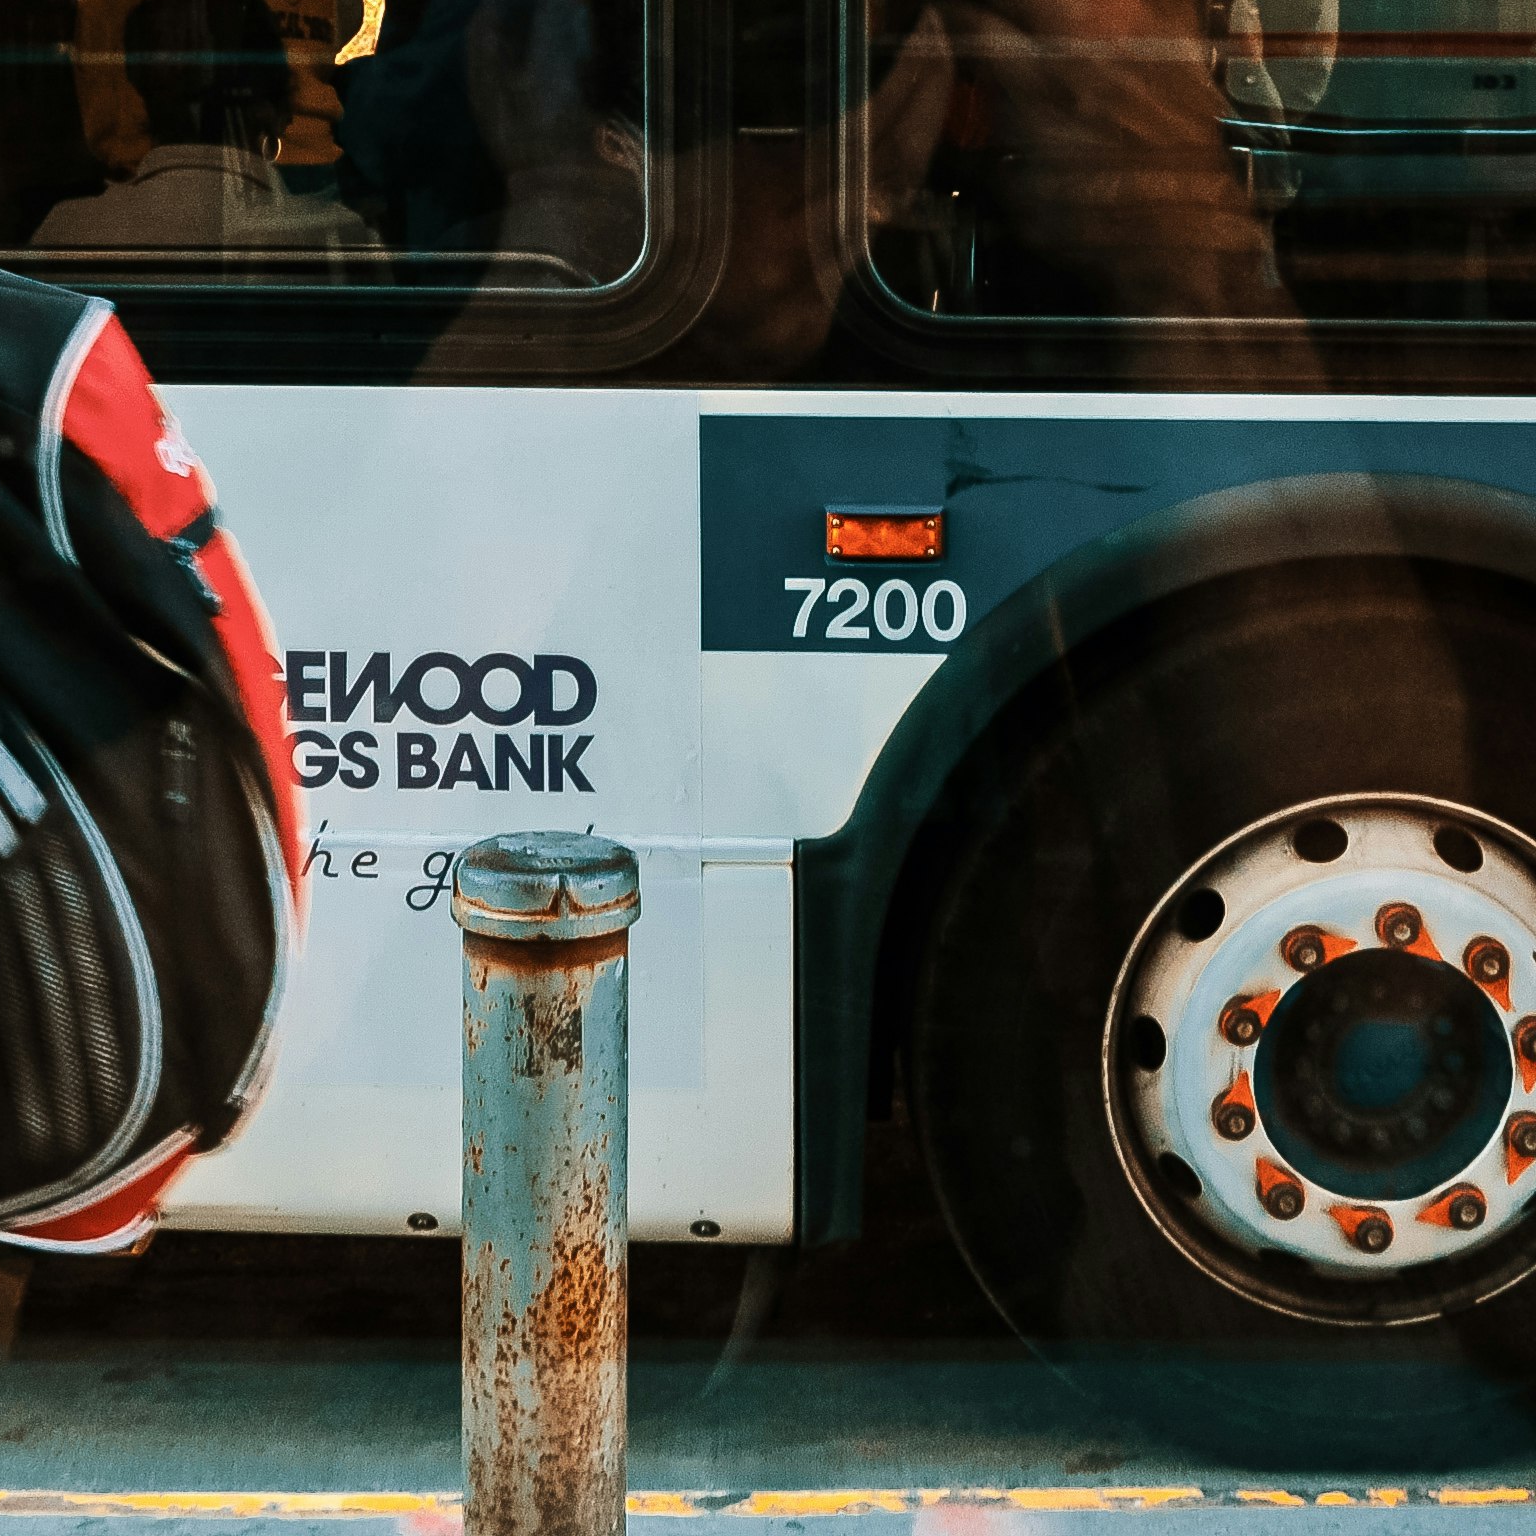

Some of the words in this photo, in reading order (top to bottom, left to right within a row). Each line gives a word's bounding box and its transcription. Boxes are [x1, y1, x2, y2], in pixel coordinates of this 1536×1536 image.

[784, 577, 967, 643] 7200
[279, 649, 598, 727] EWOOD
[396, 731, 596, 794] BANK
